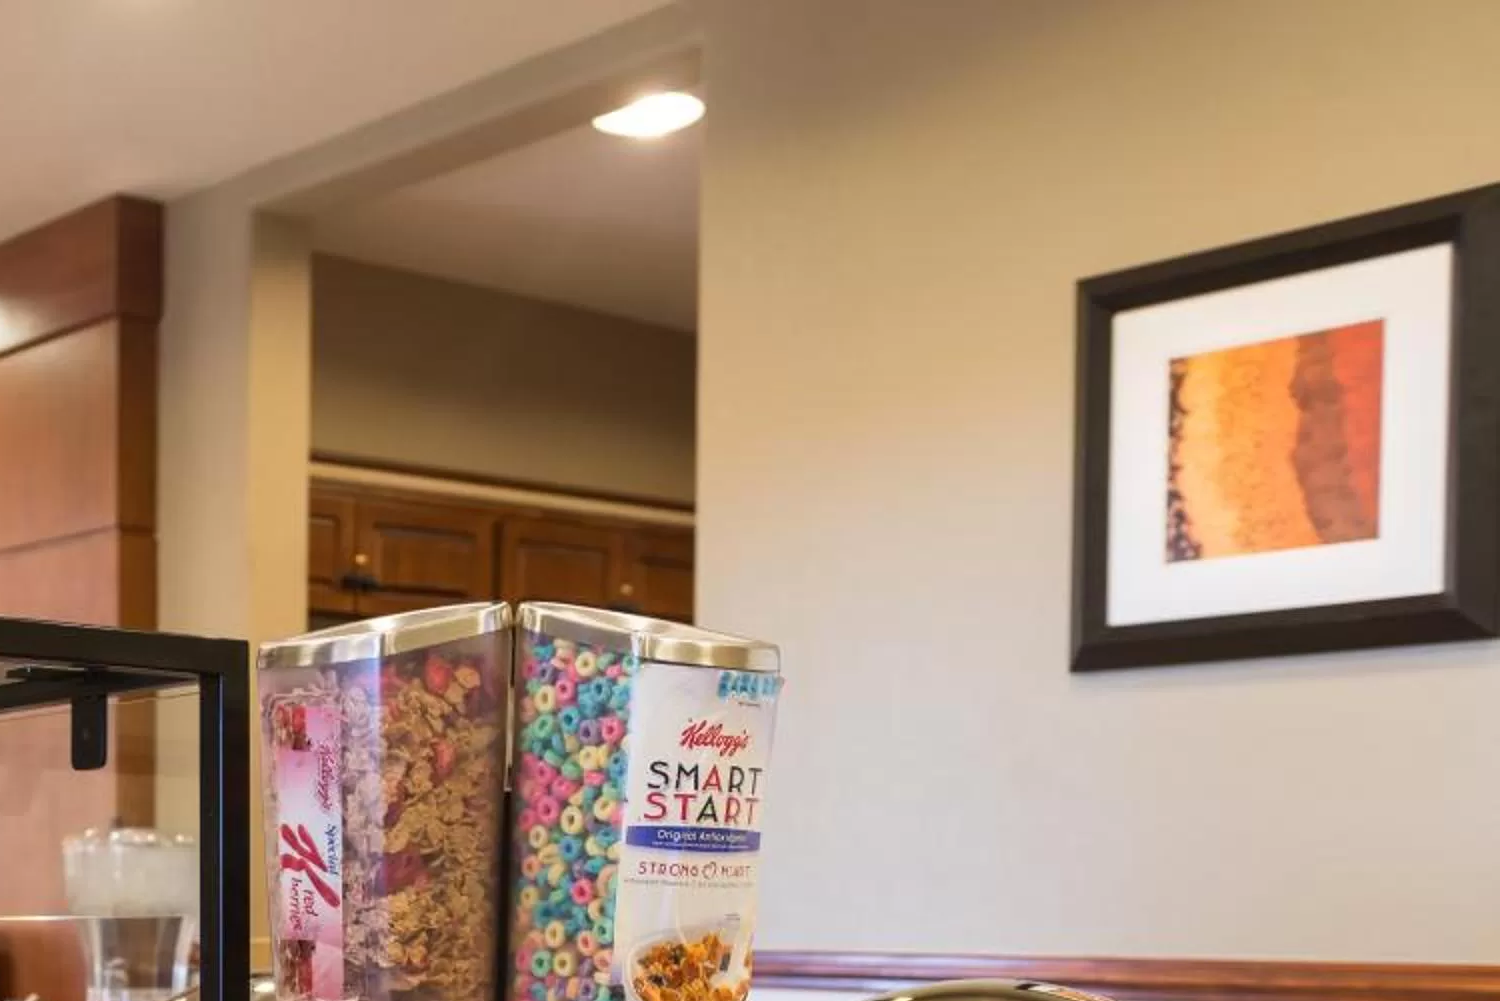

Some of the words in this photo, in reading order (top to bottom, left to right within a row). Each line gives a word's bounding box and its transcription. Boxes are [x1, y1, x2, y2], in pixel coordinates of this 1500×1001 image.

[681, 718, 750, 757] Kellogg's
[647, 761, 763, 796] SMART
[643, 792, 760, 825] START
[281, 823, 341, 910] K
[638, 861, 699, 877] STRONG
